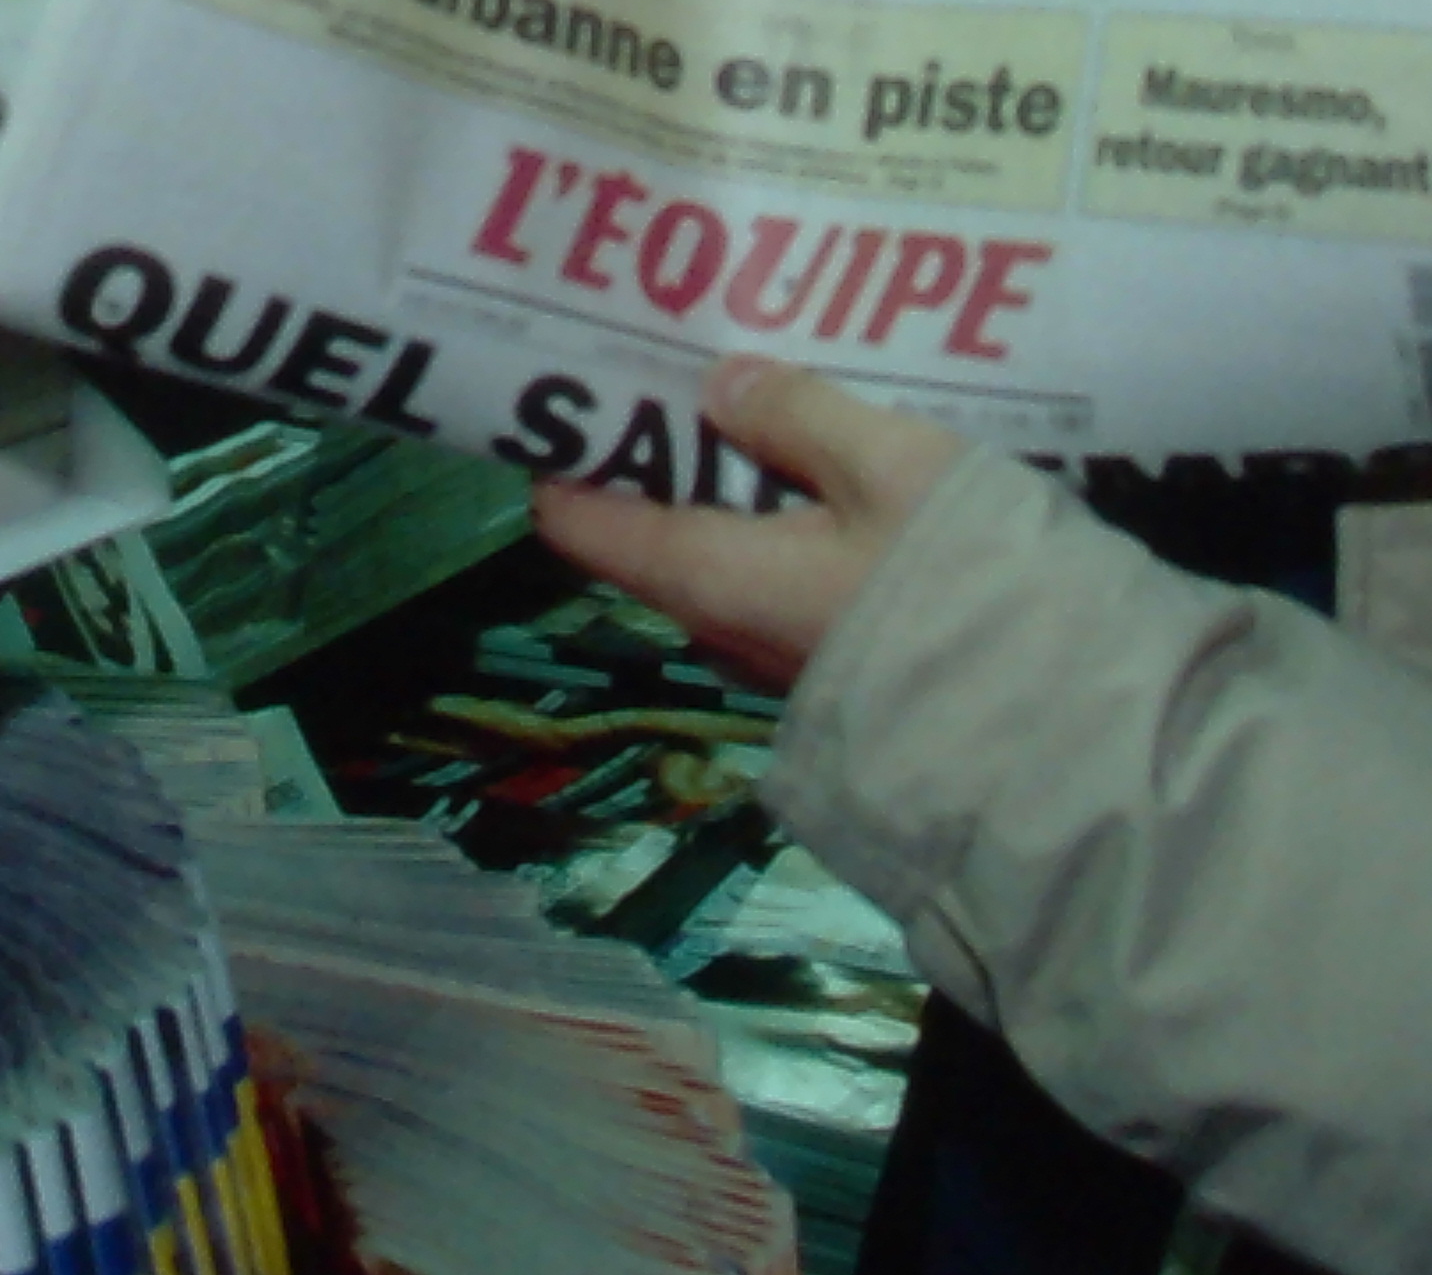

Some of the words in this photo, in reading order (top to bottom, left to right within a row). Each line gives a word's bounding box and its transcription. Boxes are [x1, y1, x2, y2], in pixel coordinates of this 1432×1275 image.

[716, 55, 833, 122] en
[861, 59, 1064, 146] piste
[1139, 65, 1389, 133] Mauresmo,
[1096, 131, 1224, 182] retour
[1237, 144, 1432, 199] gagnant
[57, 245, 440, 439] QUEL
